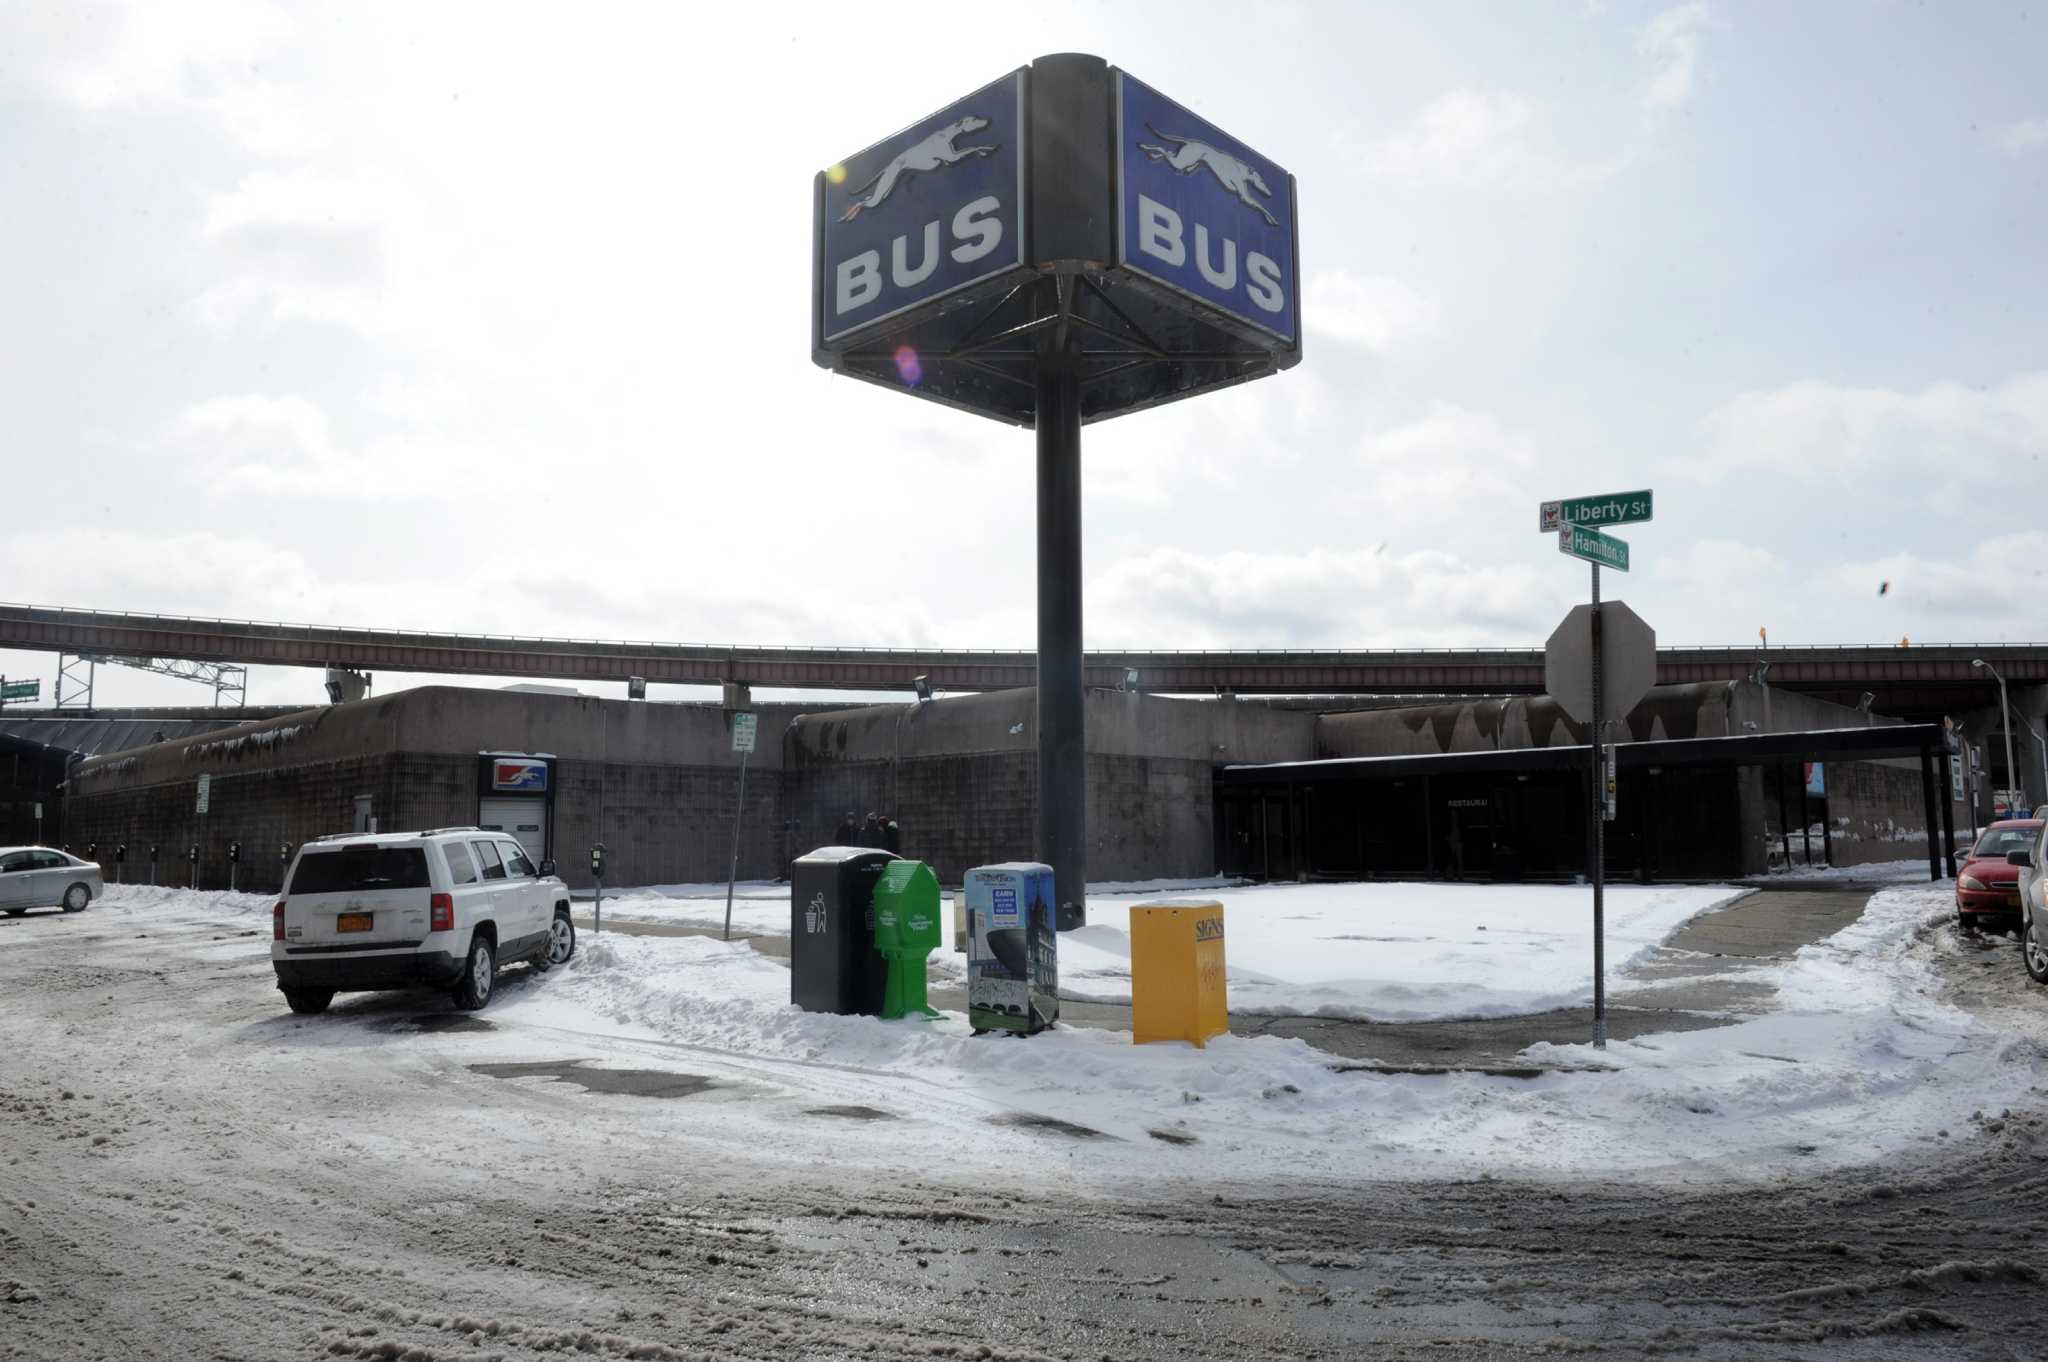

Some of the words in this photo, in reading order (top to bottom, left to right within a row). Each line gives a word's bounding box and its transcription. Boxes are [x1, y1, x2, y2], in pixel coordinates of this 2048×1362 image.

[836, 195, 1003, 315] BUS
[1138, 194, 1284, 313] BUS
[1564, 500, 1628, 522] Liberty
[1631, 501, 1647, 516] St
[1575, 531, 1618, 561] Hamilton
[1195, 917, 1225, 938] SIGNS
